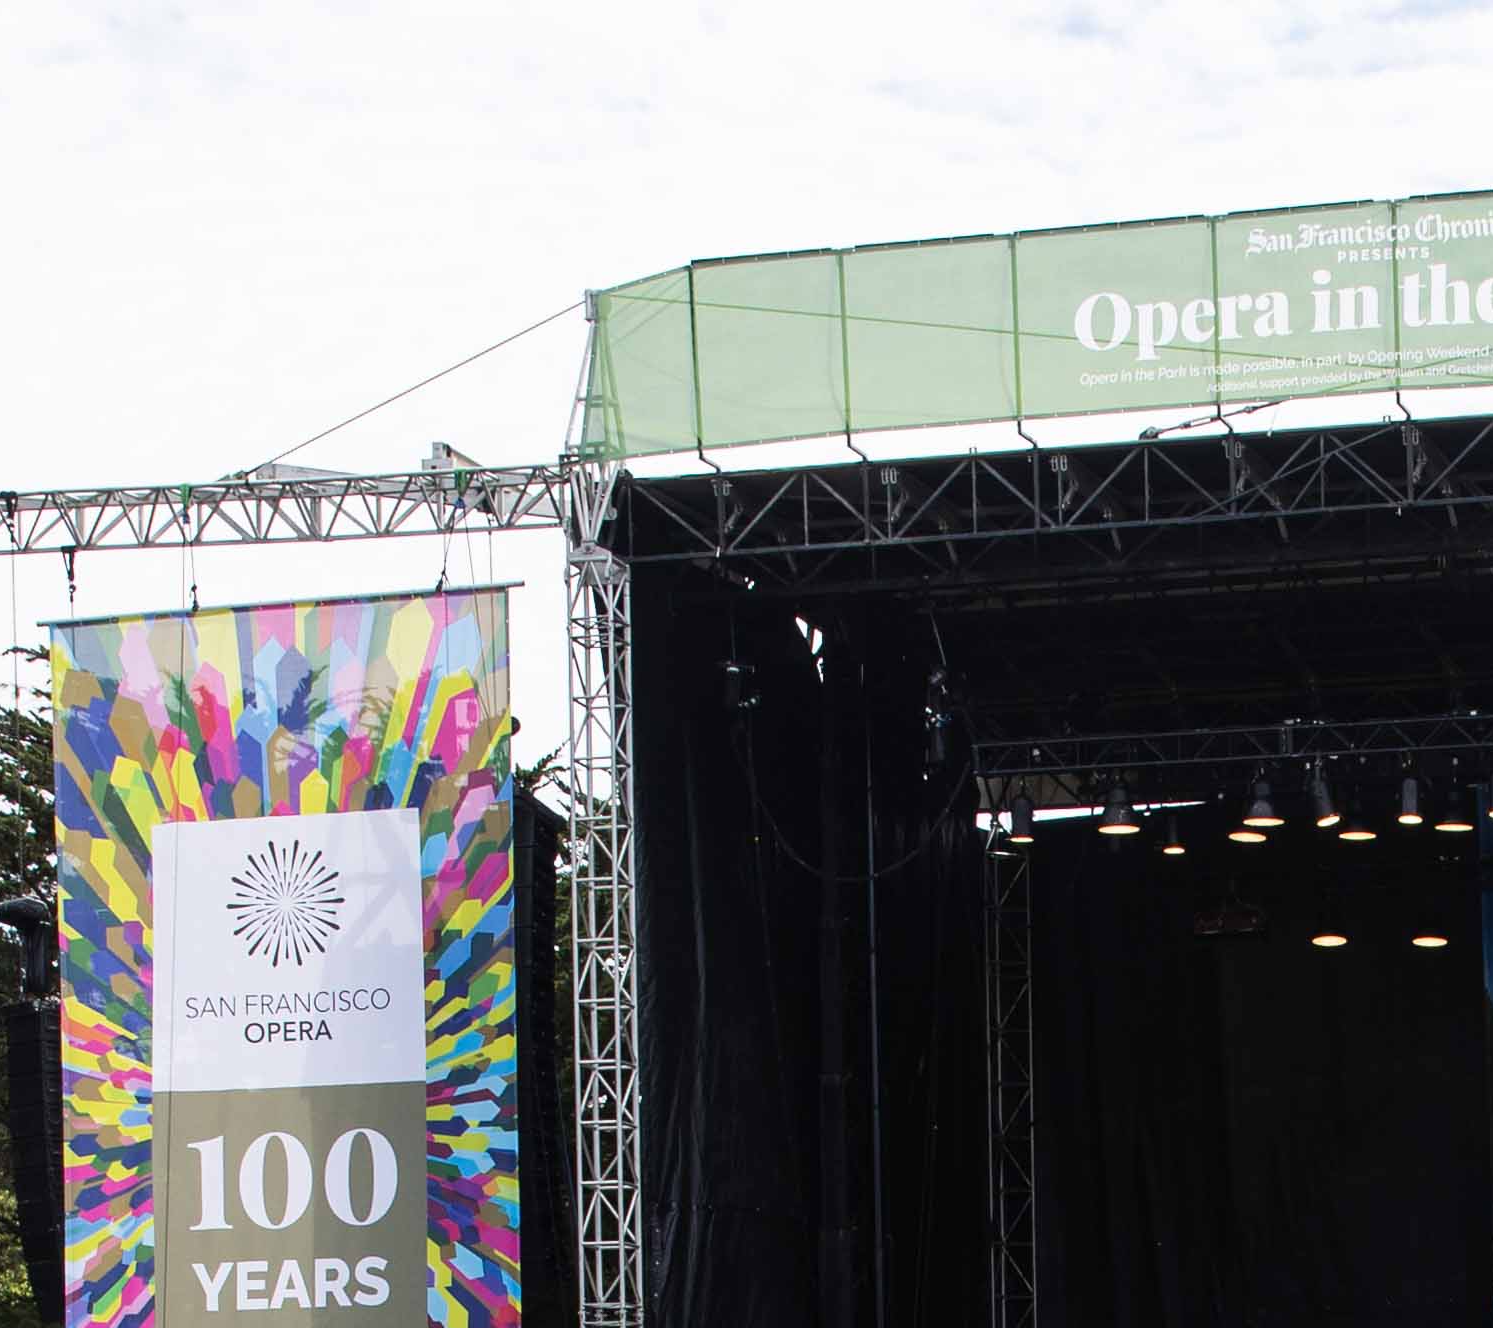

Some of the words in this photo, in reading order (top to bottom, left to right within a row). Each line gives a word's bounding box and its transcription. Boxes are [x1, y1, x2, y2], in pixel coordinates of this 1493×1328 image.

[1246, 227, 1293, 257] San
[1294, 219, 1411, 254] Francisco
[1337, 247, 1430, 263] PRESENTS
[1074, 289, 1293, 361] Opera
[1310, 269, 1382, 334] in
[1080, 371, 1117, 387] Opera
[1119, 368, 1133, 383] in
[1135, 367, 1155, 382] the
[1158, 365, 1187, 381] Park
[1189, 364, 1199, 379] is
[1203, 359, 1239, 378] made
[1300, 354, 1313, 370] in
[1348, 350, 1364, 369] by
[1367, 347, 1424, 367] Opening
[1426, 342, 1491, 362] Weekend
[1260, 376, 1298, 392] support
[1301, 372, 1350, 389] provided
[185, 996, 237, 1019] SAN
[245, 987, 391, 1016] FRANCISCO
[244, 1020, 333, 1043] OPERA
[186, 1127, 399, 1232] 100
[191, 1255, 391, 1312] YEARS
